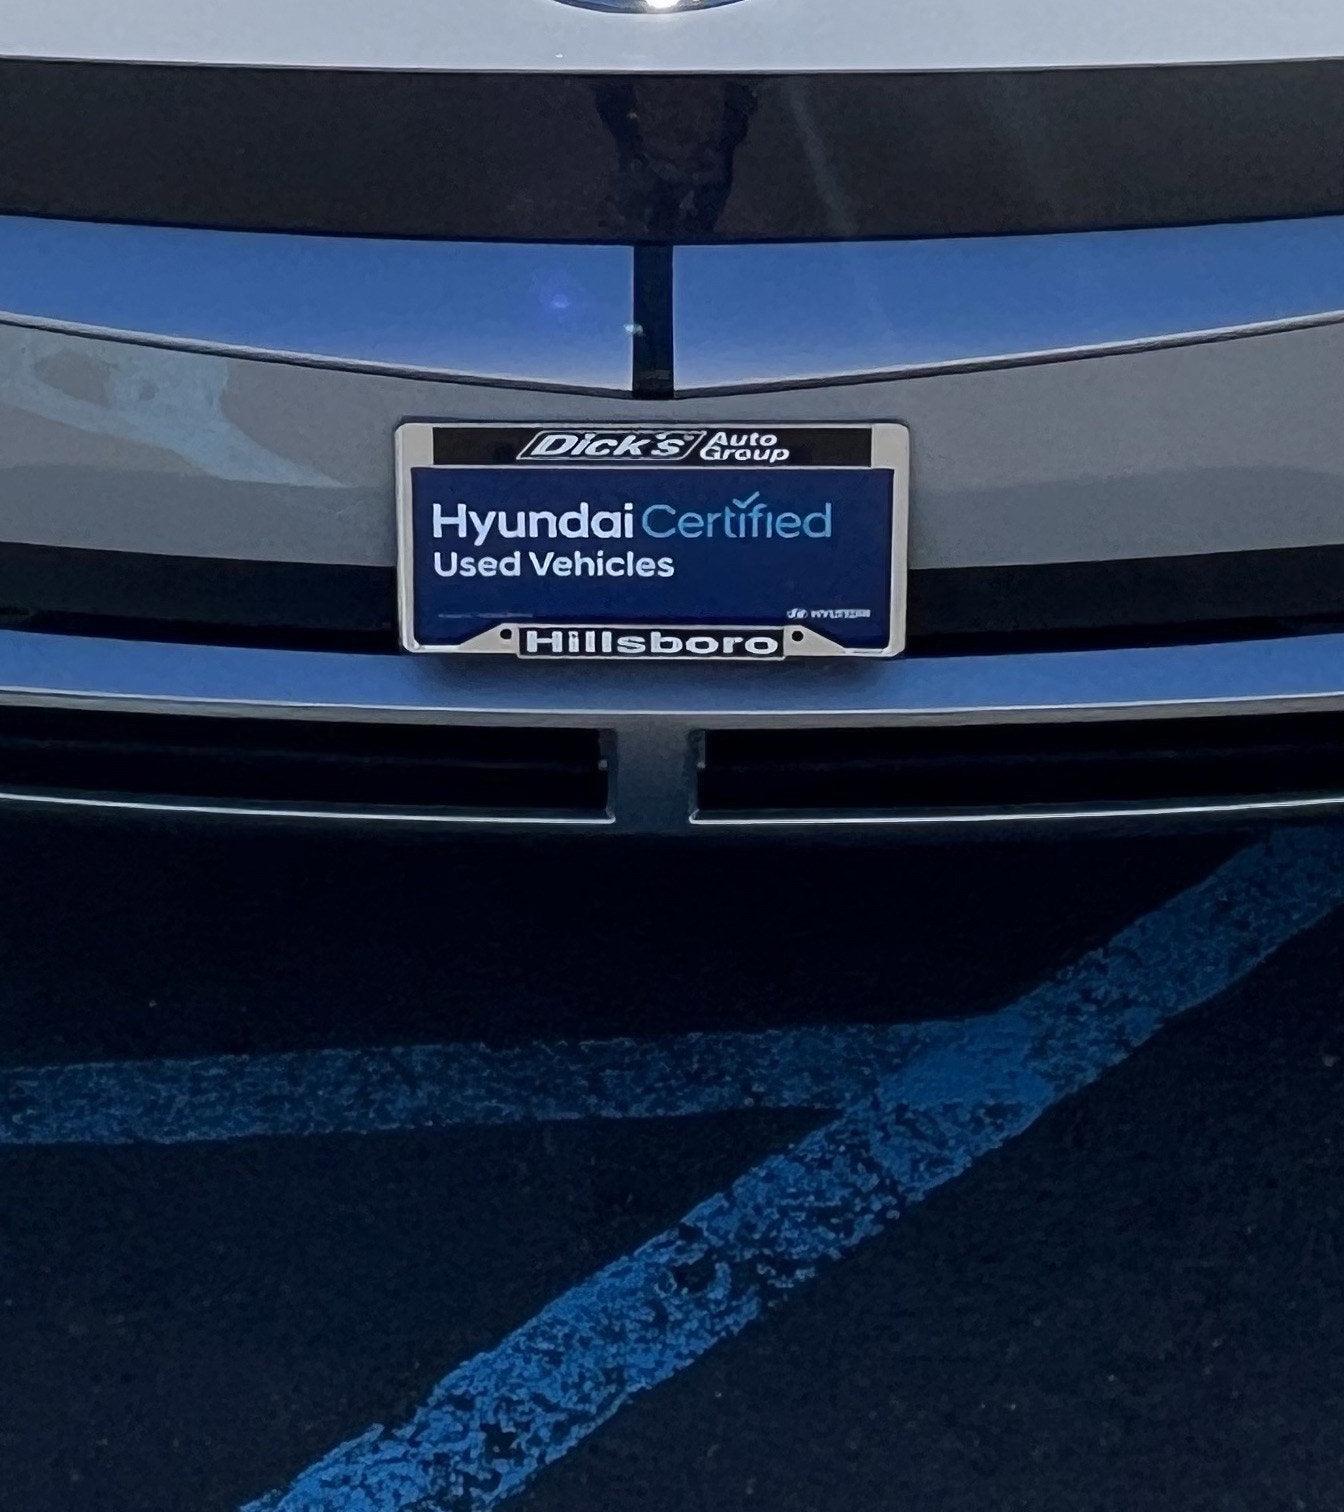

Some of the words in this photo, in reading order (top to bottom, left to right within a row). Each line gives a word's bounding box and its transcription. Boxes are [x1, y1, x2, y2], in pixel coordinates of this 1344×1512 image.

[530, 433, 688, 457] Dick's
[710, 431, 778, 447] Auto
[700, 445, 790, 464] Group
[432, 502, 634, 546] Hyundai
[641, 494, 832, 538] Certified
[433, 551, 521, 578] Used
[529, 550, 675, 578] Vehicles
[526, 630, 779, 655] Hillsboro
